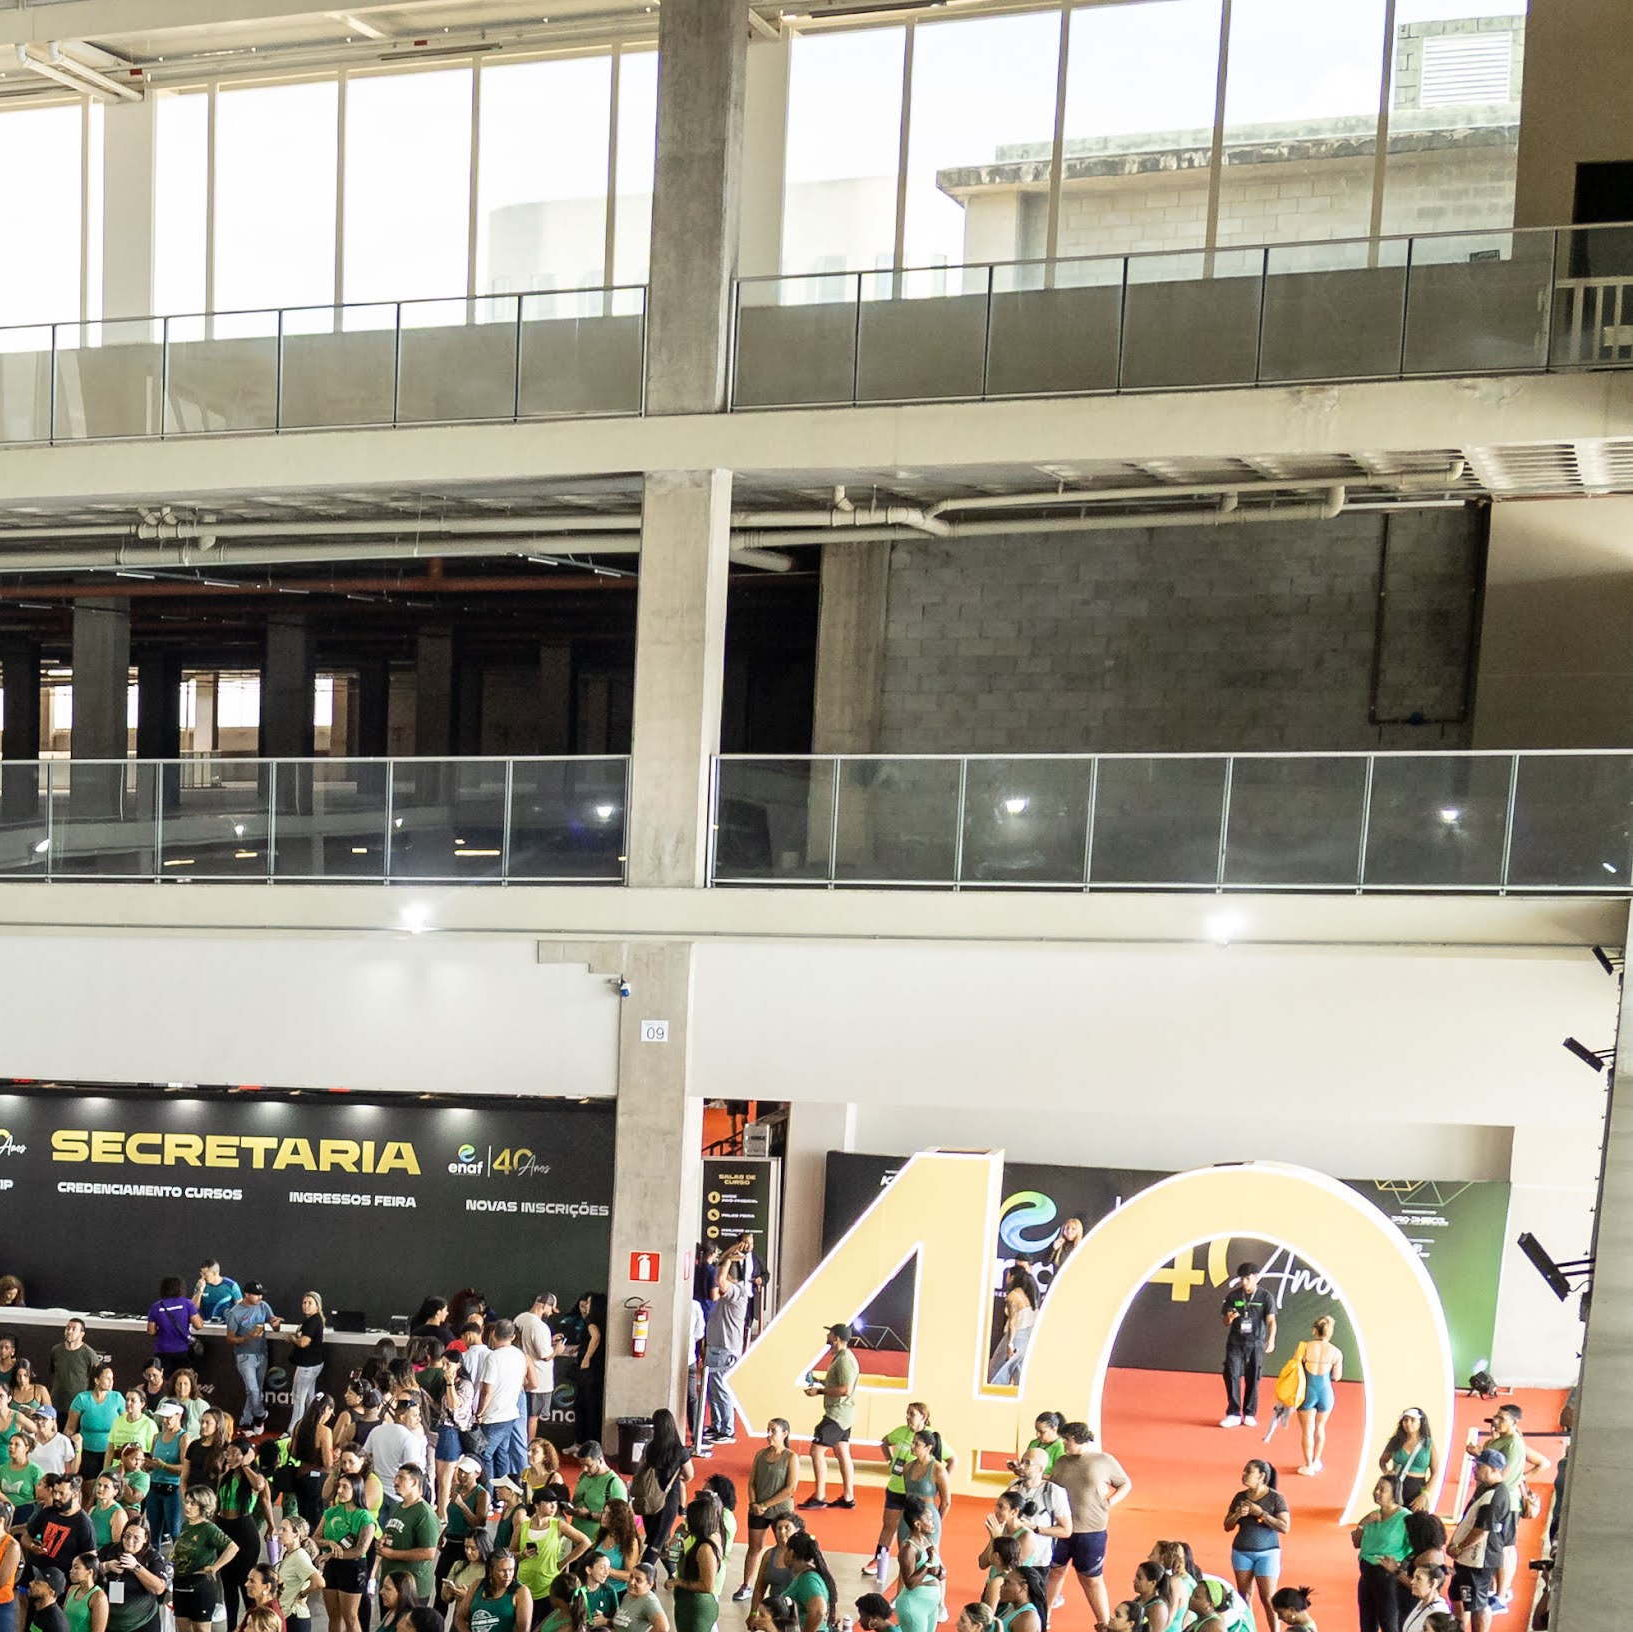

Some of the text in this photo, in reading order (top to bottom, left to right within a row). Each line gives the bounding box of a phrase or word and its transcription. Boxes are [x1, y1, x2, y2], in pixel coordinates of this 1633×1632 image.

[646, 1027, 664, 1040] 09
[50, 1128, 423, 1177] SECRETARIA
[492, 1147, 533, 1176] 40
[448, 1161, 484, 1176] enaf
[57, 1181, 243, 1201] CREDENCIAMENTO CURSOS
[289, 1191, 417, 1208] INGRESSOS FEIRA
[465, 1198, 610, 1219] NOVAS INSCRIÇÕES
[727, 1147, 1455, 1528] 40
